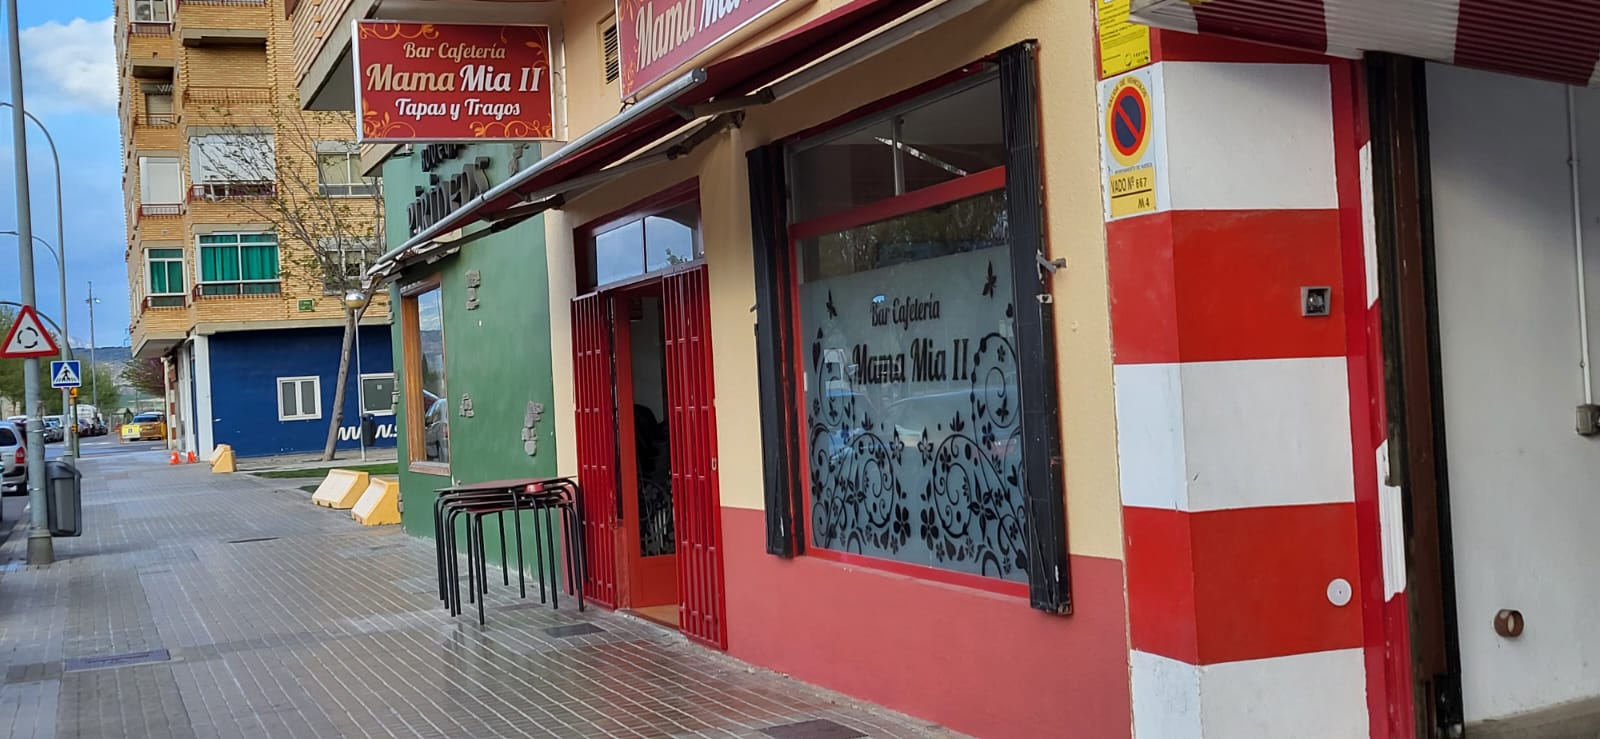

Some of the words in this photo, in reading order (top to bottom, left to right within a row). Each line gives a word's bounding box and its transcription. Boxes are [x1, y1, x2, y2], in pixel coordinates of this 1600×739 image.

[635, 0, 696, 73] Mama
[403, 41, 434, 59] Bar
[438, 42, 506, 63] Cafetería
[366, 63, 455, 92] Mama
[459, 64, 511, 92] Mia
[518, 67, 543, 92] II
[394, 98, 447, 121] Tapas
[450, 102, 461, 120] y
[464, 98, 520, 121] Tragos
[1111, 178, 1127, 193] VADO
[870, 302, 890, 327] Bar
[892, 293, 940, 331] Cafetería
[852, 344, 905, 385] Mama
[910, 338, 947, 383] Mia
[952, 338, 969, 381] II
